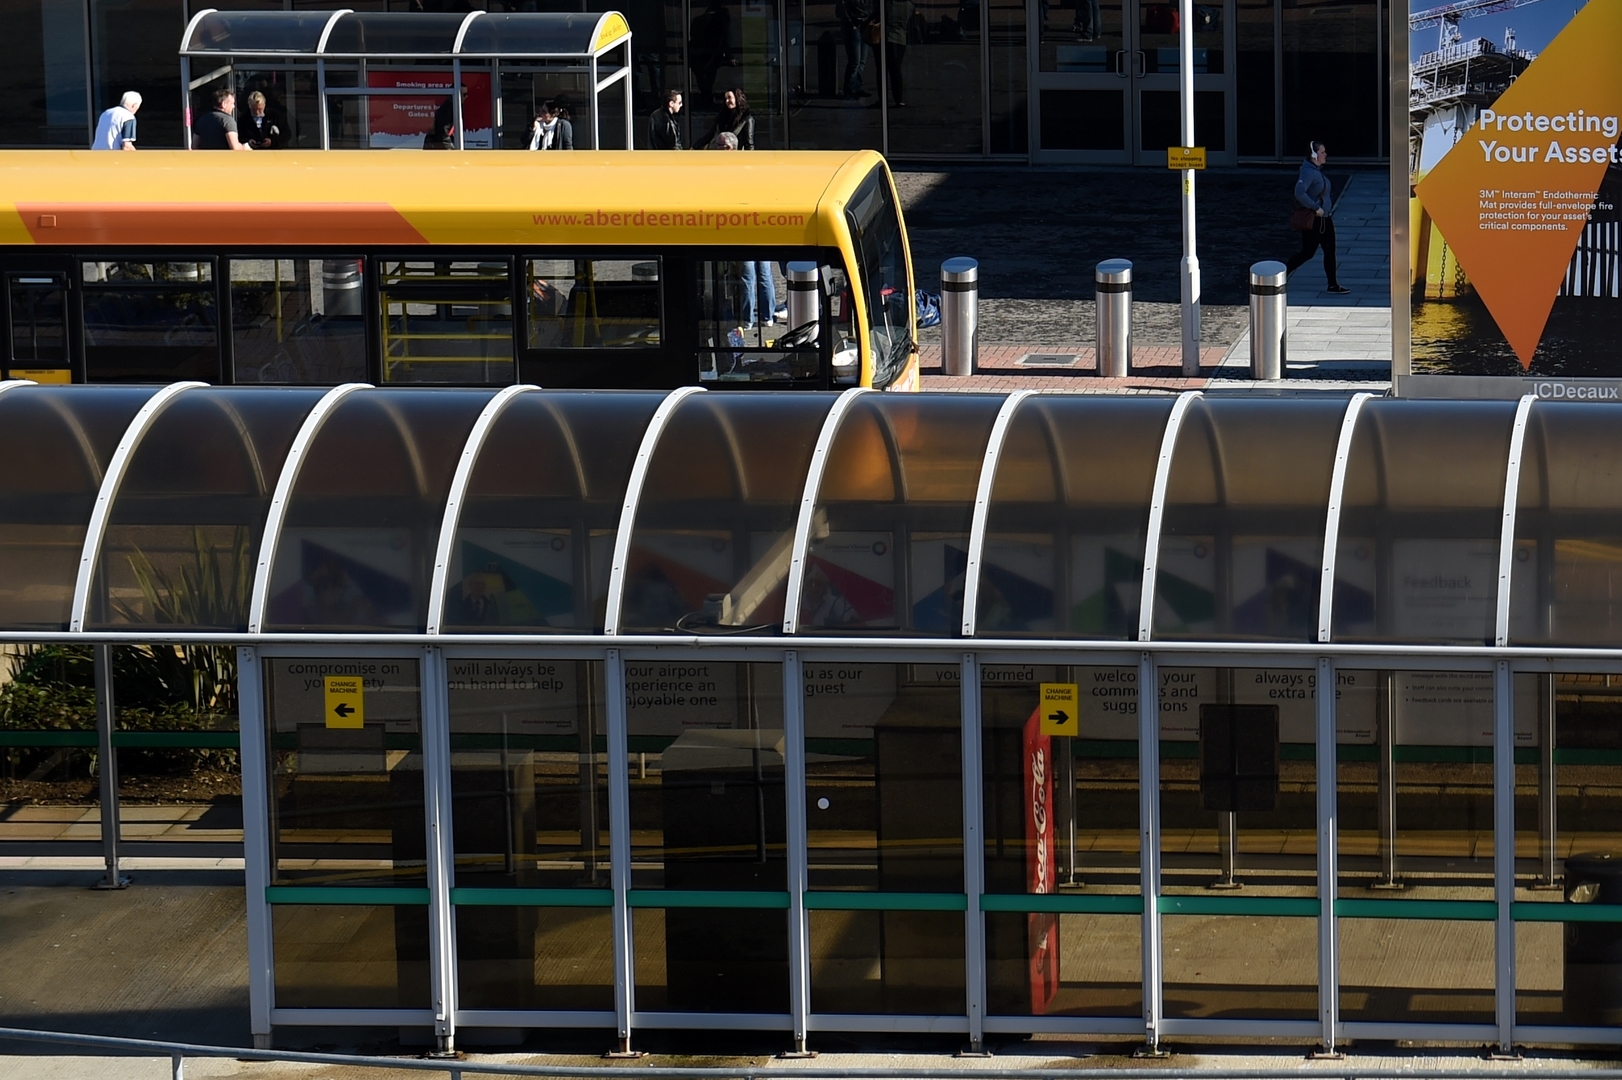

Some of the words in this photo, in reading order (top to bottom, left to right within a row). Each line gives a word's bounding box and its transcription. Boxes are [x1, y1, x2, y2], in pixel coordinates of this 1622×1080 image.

[1479, 109, 1619, 138] Protecting
[1479, 140, 1539, 162] Your
[1543, 191, 1599, 200] Endothermic
[1479, 201, 1497, 209] Mat
[1499, 202, 1537, 210] provides
[1539, 202, 1597, 211] full-envelope
[1598, 202, 1614, 210] fire
[532, 208, 804, 230] www.aberdeenairport.com
[1479, 212, 1525, 221] protection
[1527, 212, 1539, 220] for
[1541, 213, 1561, 222] your
[1479, 222, 1509, 230] critical
[1511, 222, 1568, 232] components.
[1404, 576, 1472, 589] Feedback
[288, 662, 376, 676] compromise
[381, 665, 400, 674] on
[454, 663, 479, 675] will
[484, 663, 533, 678] always
[538, 663, 555, 676] be
[659, 664, 709, 679] airport
[818, 670, 833, 679] as
[838, 669, 862, 679] our
[981, 668, 1034, 680] formed
[448, 680, 465, 690] on
[470, 678, 507, 690] hand
[512, 680, 527, 690] to
[532, 678, 564, 692] help
[1163, 673, 1196, 686] your
[1255, 671, 1303, 687] always
[625, 679, 693, 694] xperience
[698, 682, 716, 692] an
[806, 682, 845, 697] guest
[1171, 685, 1198, 697] and
[1269, 688, 1305, 699] extra
[626, 694, 685, 708] njoyable
[690, 696, 717, 706] one
